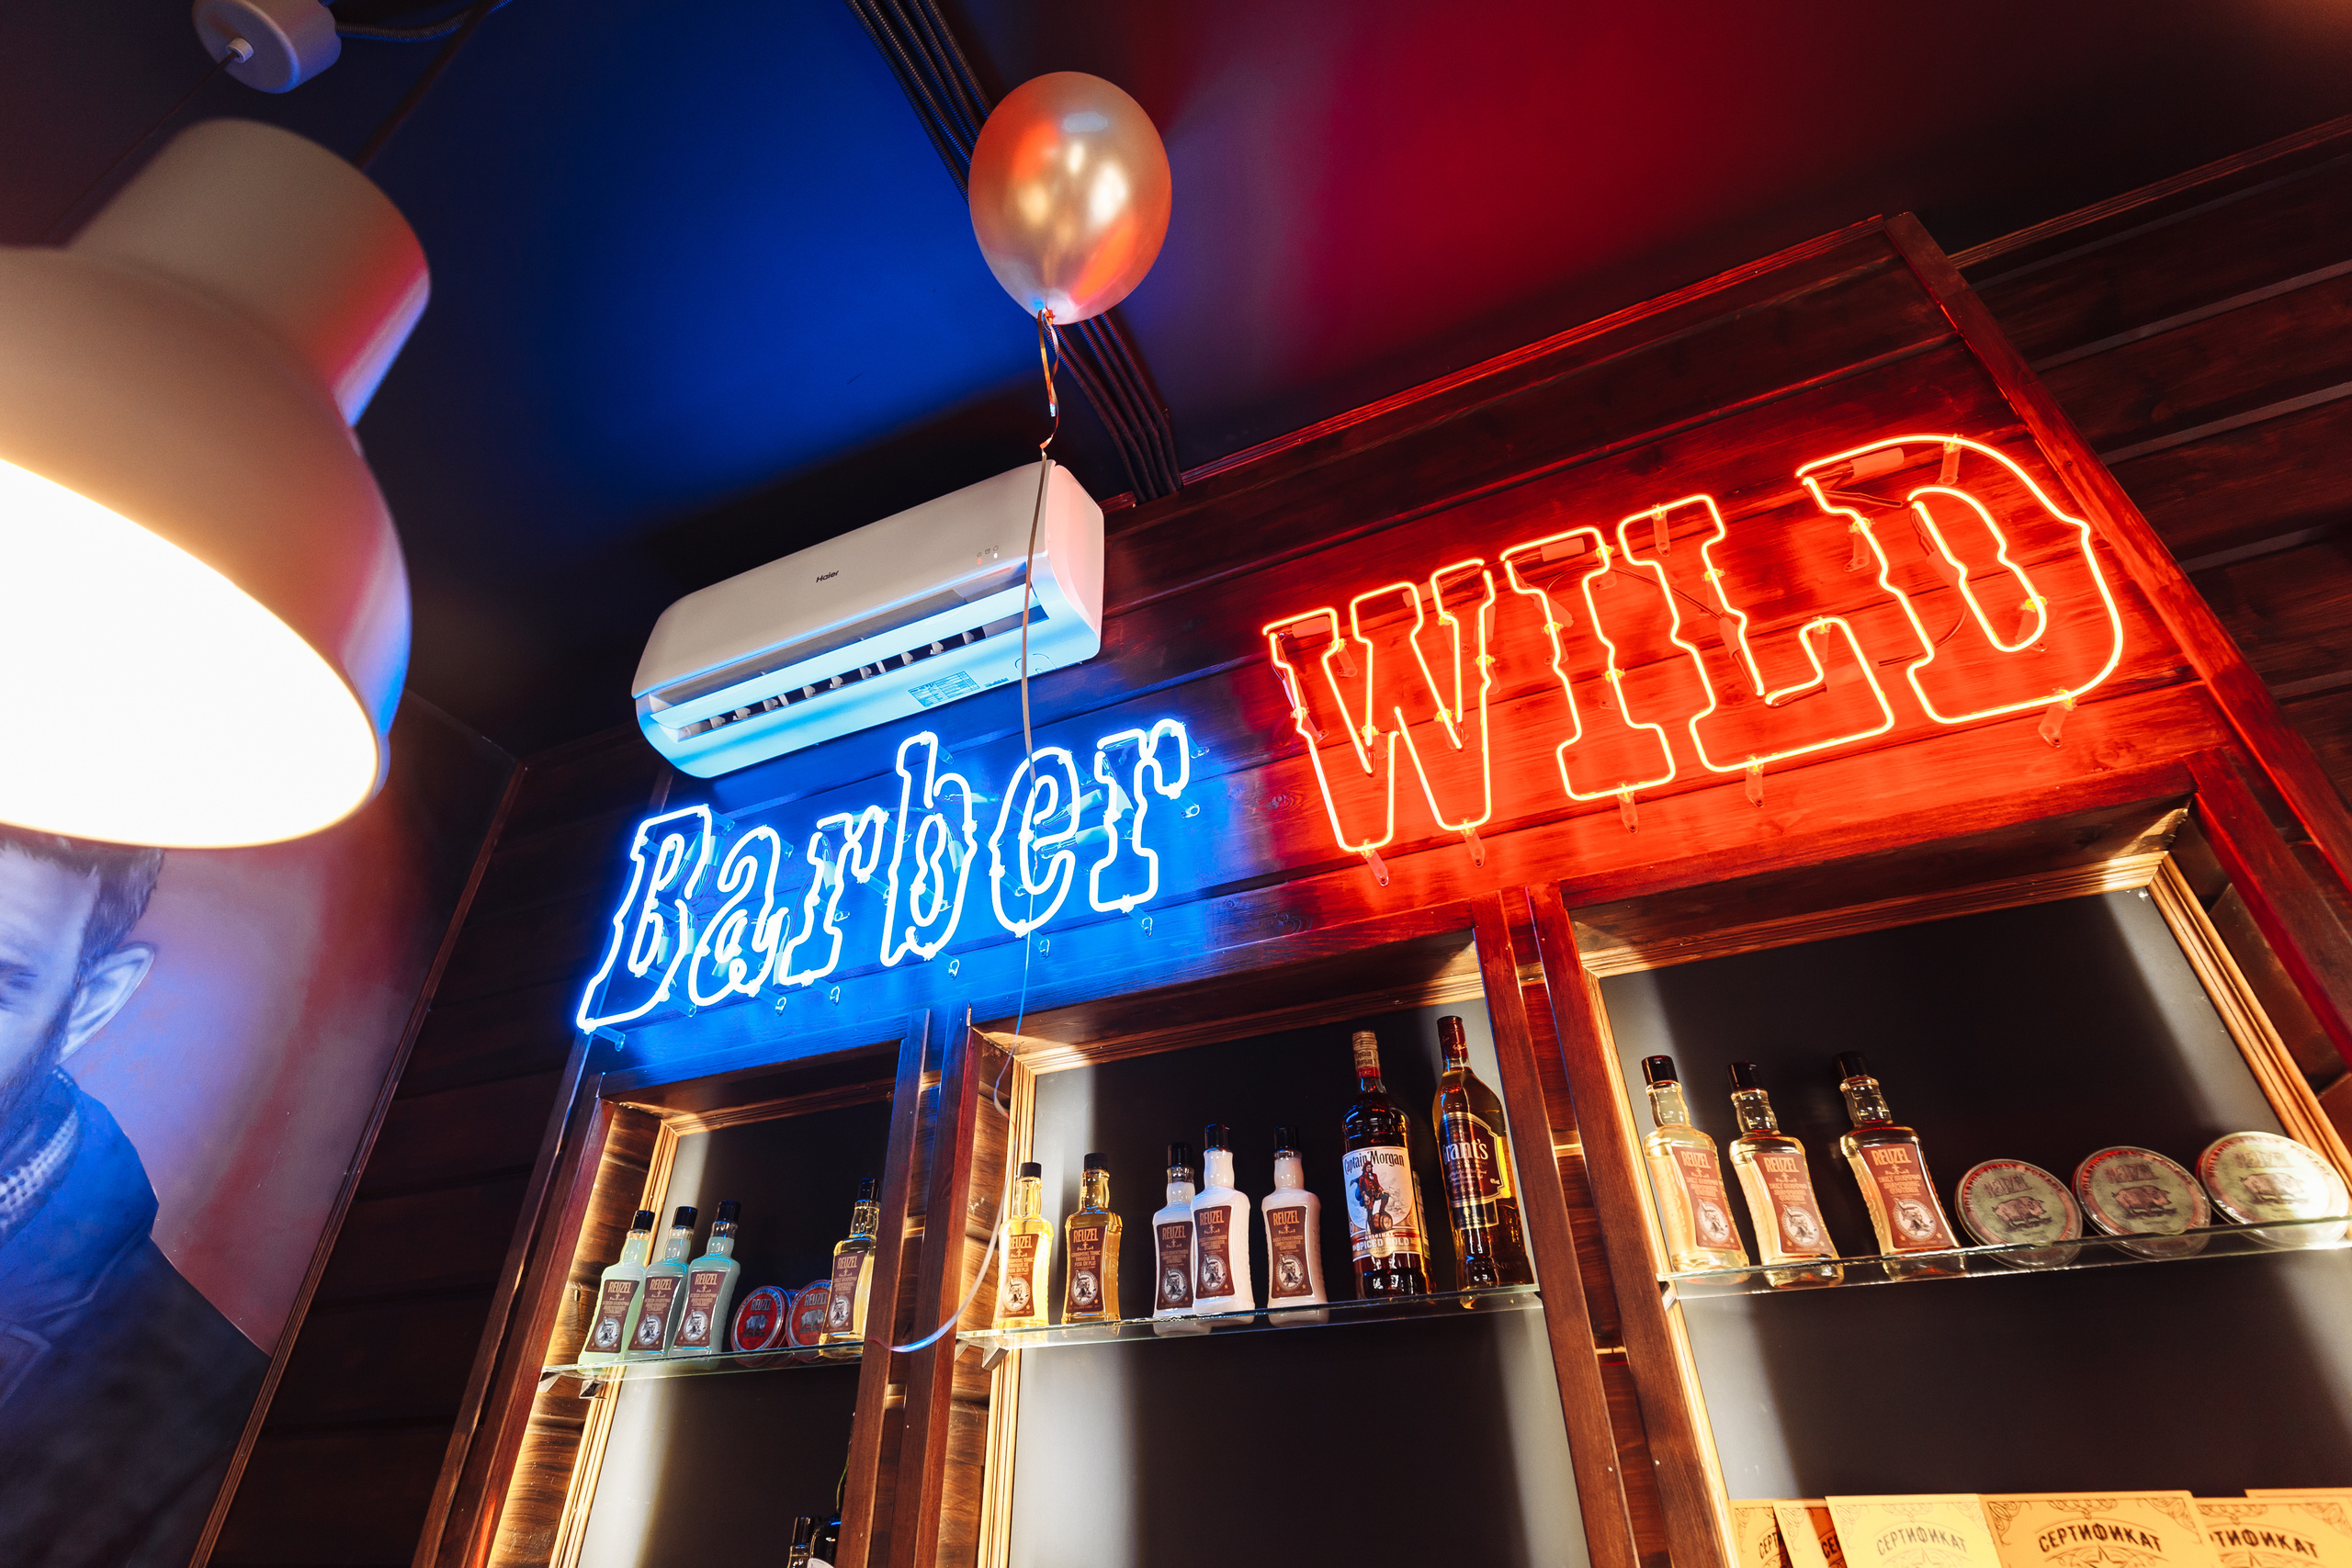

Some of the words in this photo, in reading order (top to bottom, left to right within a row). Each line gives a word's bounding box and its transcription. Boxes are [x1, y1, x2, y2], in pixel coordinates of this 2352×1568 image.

[816, 570, 839, 583] Haier
[1261, 434, 2123, 852] WILD
[575, 717, 1192, 1033] Barber
[1344, 1154, 1367, 1175] Captain
[1367, 1150, 1405, 1168] Morgan
[1680, 1150, 1712, 1169] REUZEL
[1871, 1147, 1913, 1166] REUZEL
[1763, 1156, 1801, 1173] REUZEL
[1982, 1174, 2033, 1199] REUZEL
[1199, 1210, 1225, 1225] REUZEL
[1272, 1210, 1300, 1225] REUZEL
[1073, 1227, 1099, 1243] REUZEL
[1162, 1225, 1186, 1240] REUZEL
[1009, 1235, 1033, 1250] REUZEL
[1356, 1238, 1384, 1251] SPICED
[1385, 1236, 1410, 1247] GOLD
[837, 1256, 858, 1269] REUZEL
[650, 1279, 672, 1291] REUZEL
[695, 1273, 718, 1285] REUZEL
[608, 1281, 632, 1293] REUZEL
[750, 1298, 772, 1311] REUZEL
[1876, 1526, 1968, 1556] СЕРТИФИКАТ
[2038, 1522, 2163, 1553] СЕРТИФИКАТ
[2209, 1529, 2319, 1558] ТИФИКАТ
